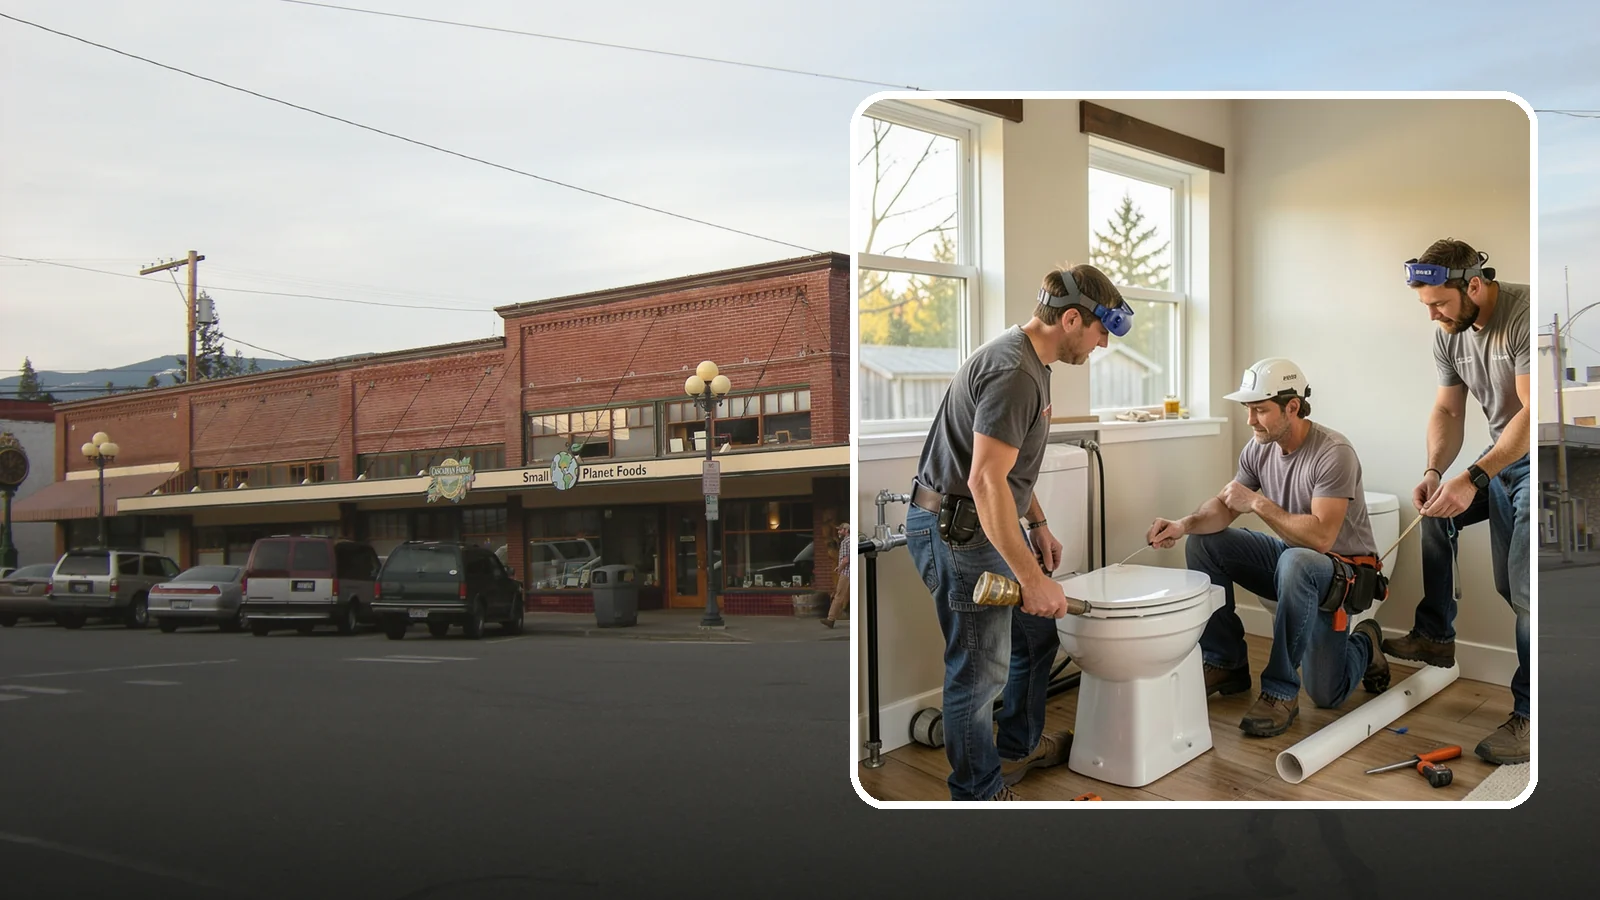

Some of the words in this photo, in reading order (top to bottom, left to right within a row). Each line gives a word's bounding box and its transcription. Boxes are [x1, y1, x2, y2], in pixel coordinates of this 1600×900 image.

[523, 471, 549, 483] Small
[583, 467, 614, 479] Planet
[617, 464, 647, 477] Foods
